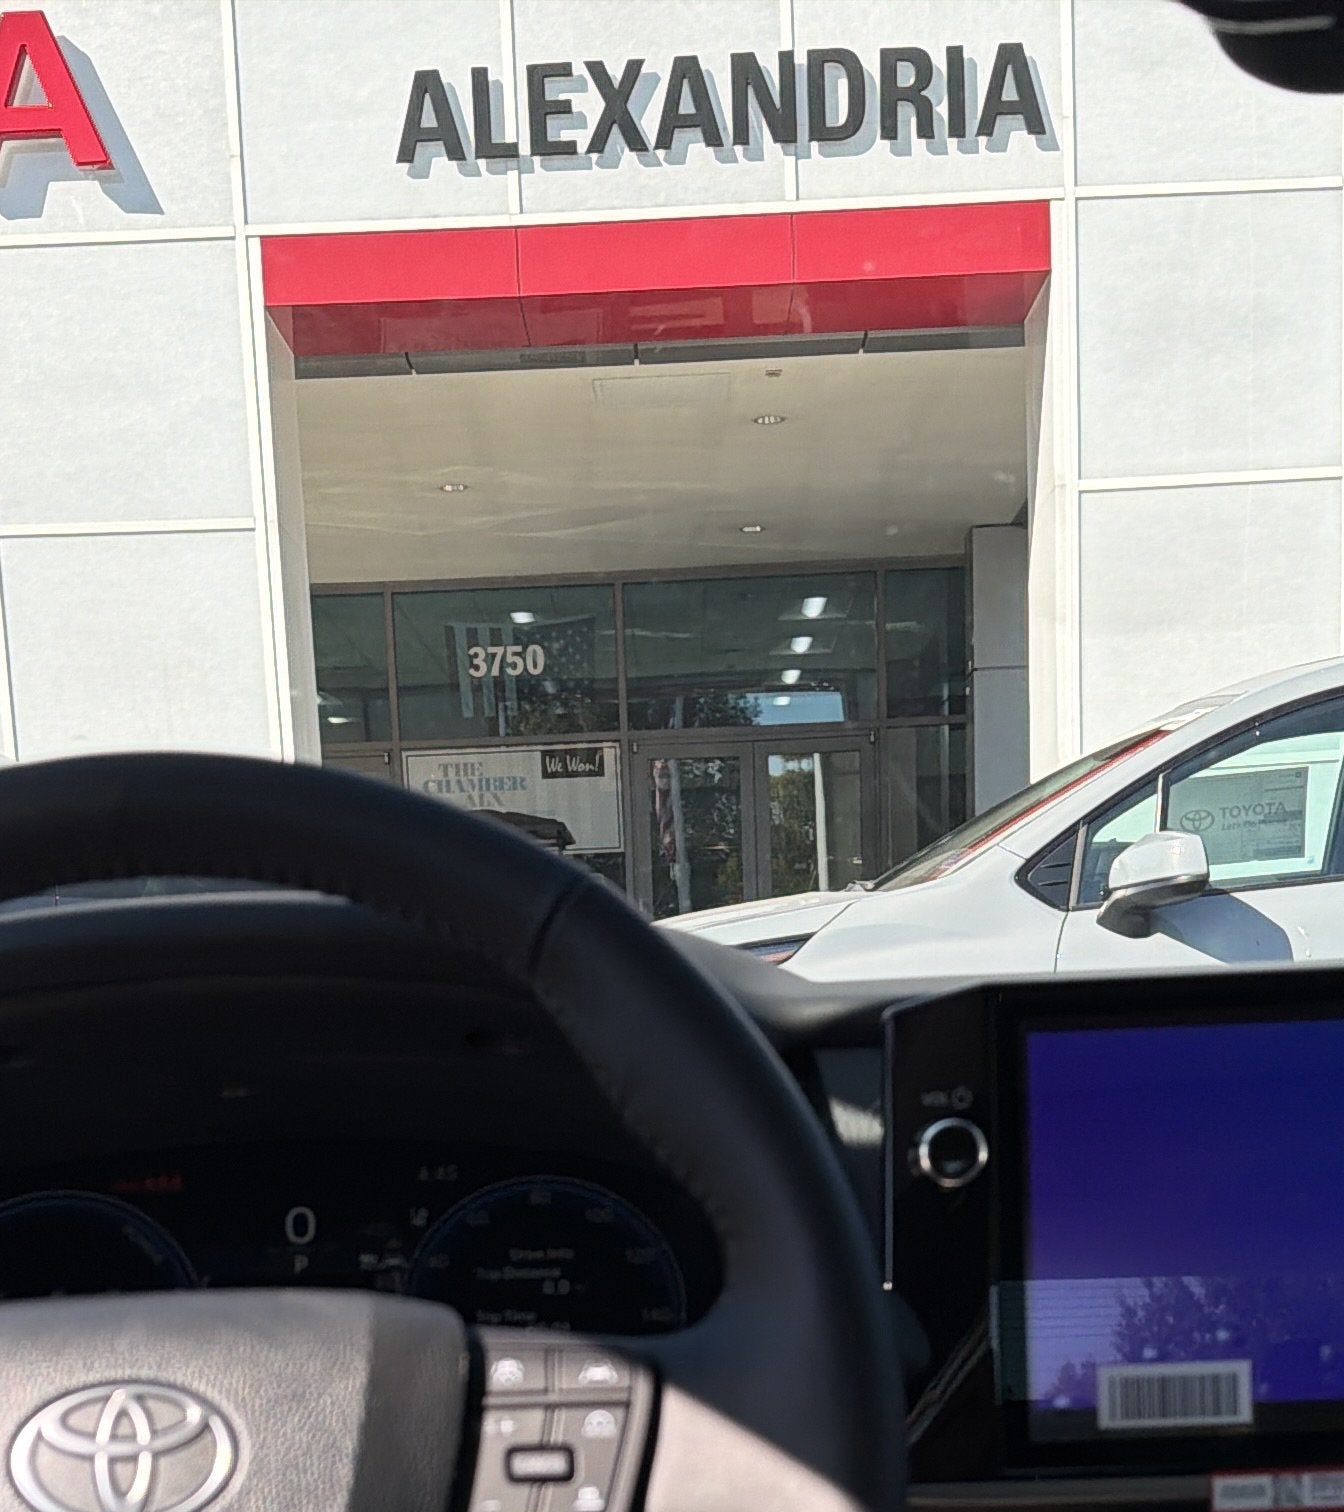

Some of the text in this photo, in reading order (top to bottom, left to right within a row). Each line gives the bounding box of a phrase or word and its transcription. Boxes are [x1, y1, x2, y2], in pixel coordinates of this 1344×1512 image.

[398, 42, 1046, 164] ALEXANDRIA
[467, 643, 545, 678] 3750
[438, 761, 484, 778] THE
[545, 750, 603, 774] We Won!
[423, 776, 529, 795] CHAMBER
[1219, 802, 1287, 819] TOYOTA
[284, 1205, 318, 1244] 0
